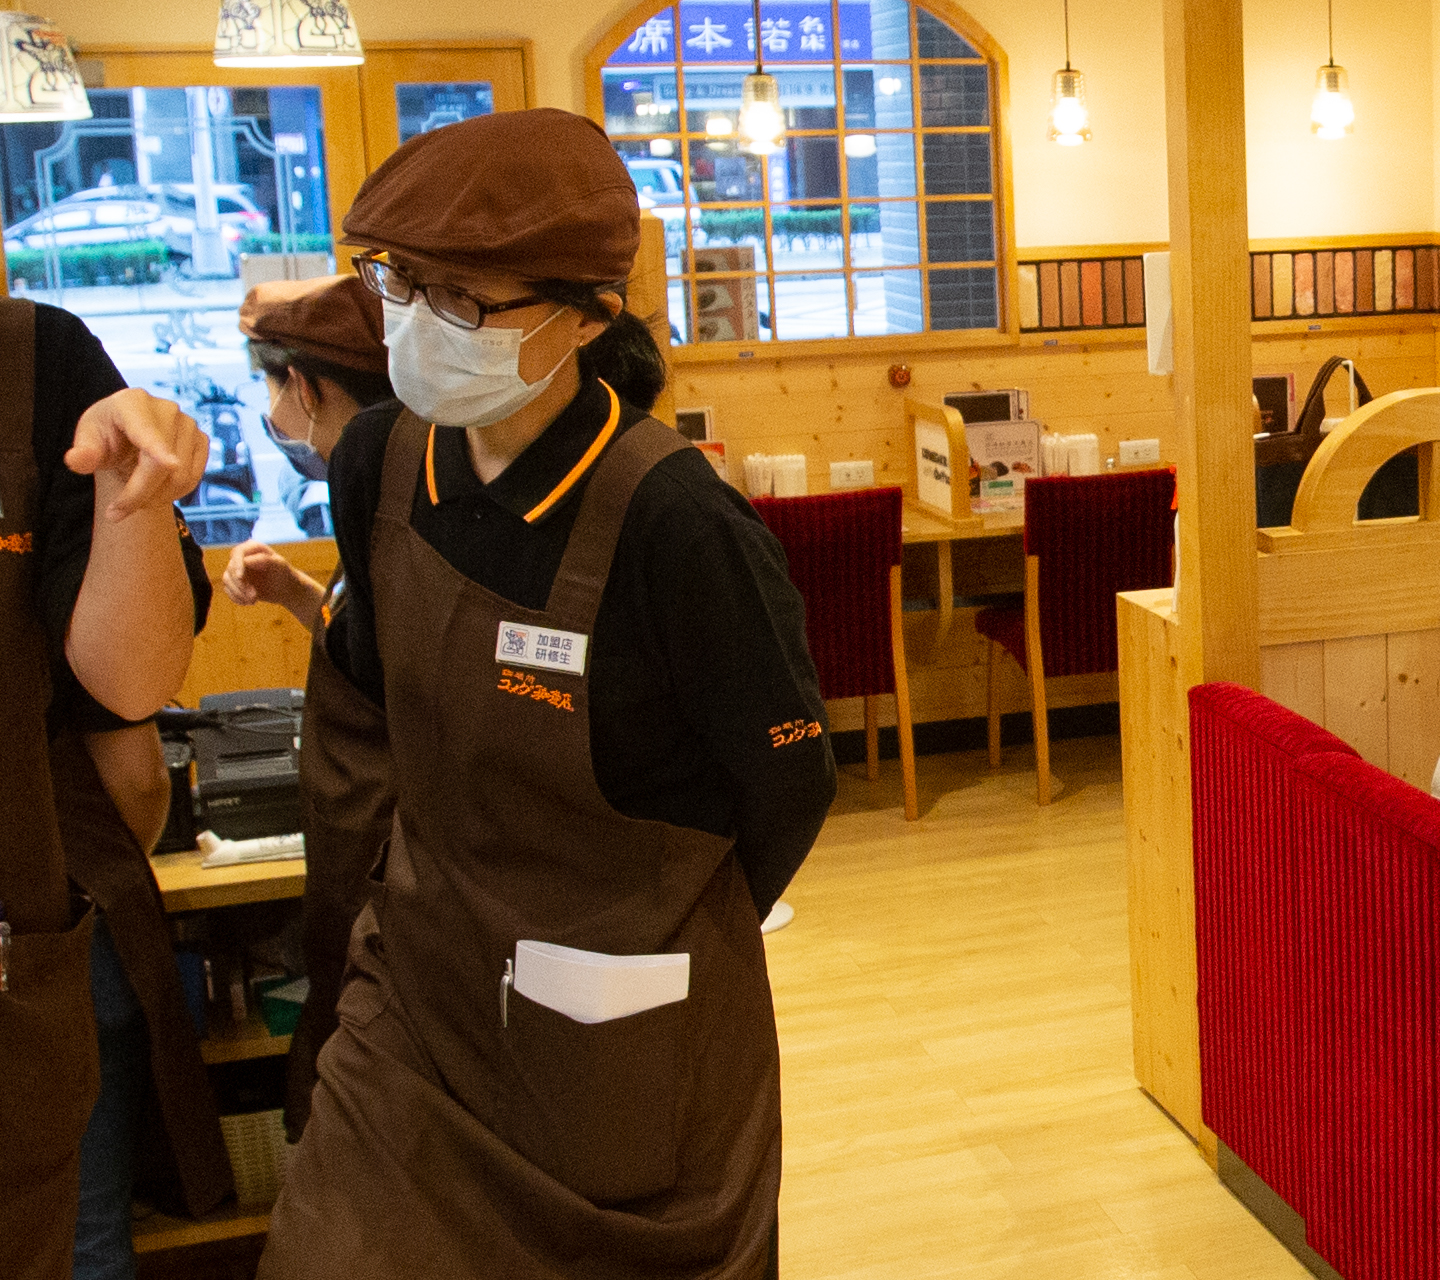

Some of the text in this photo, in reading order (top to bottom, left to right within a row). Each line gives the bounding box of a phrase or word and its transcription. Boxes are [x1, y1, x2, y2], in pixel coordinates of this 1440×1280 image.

[536, 633, 574, 651] 加盟店
[535, 647, 572, 665] 研修生
